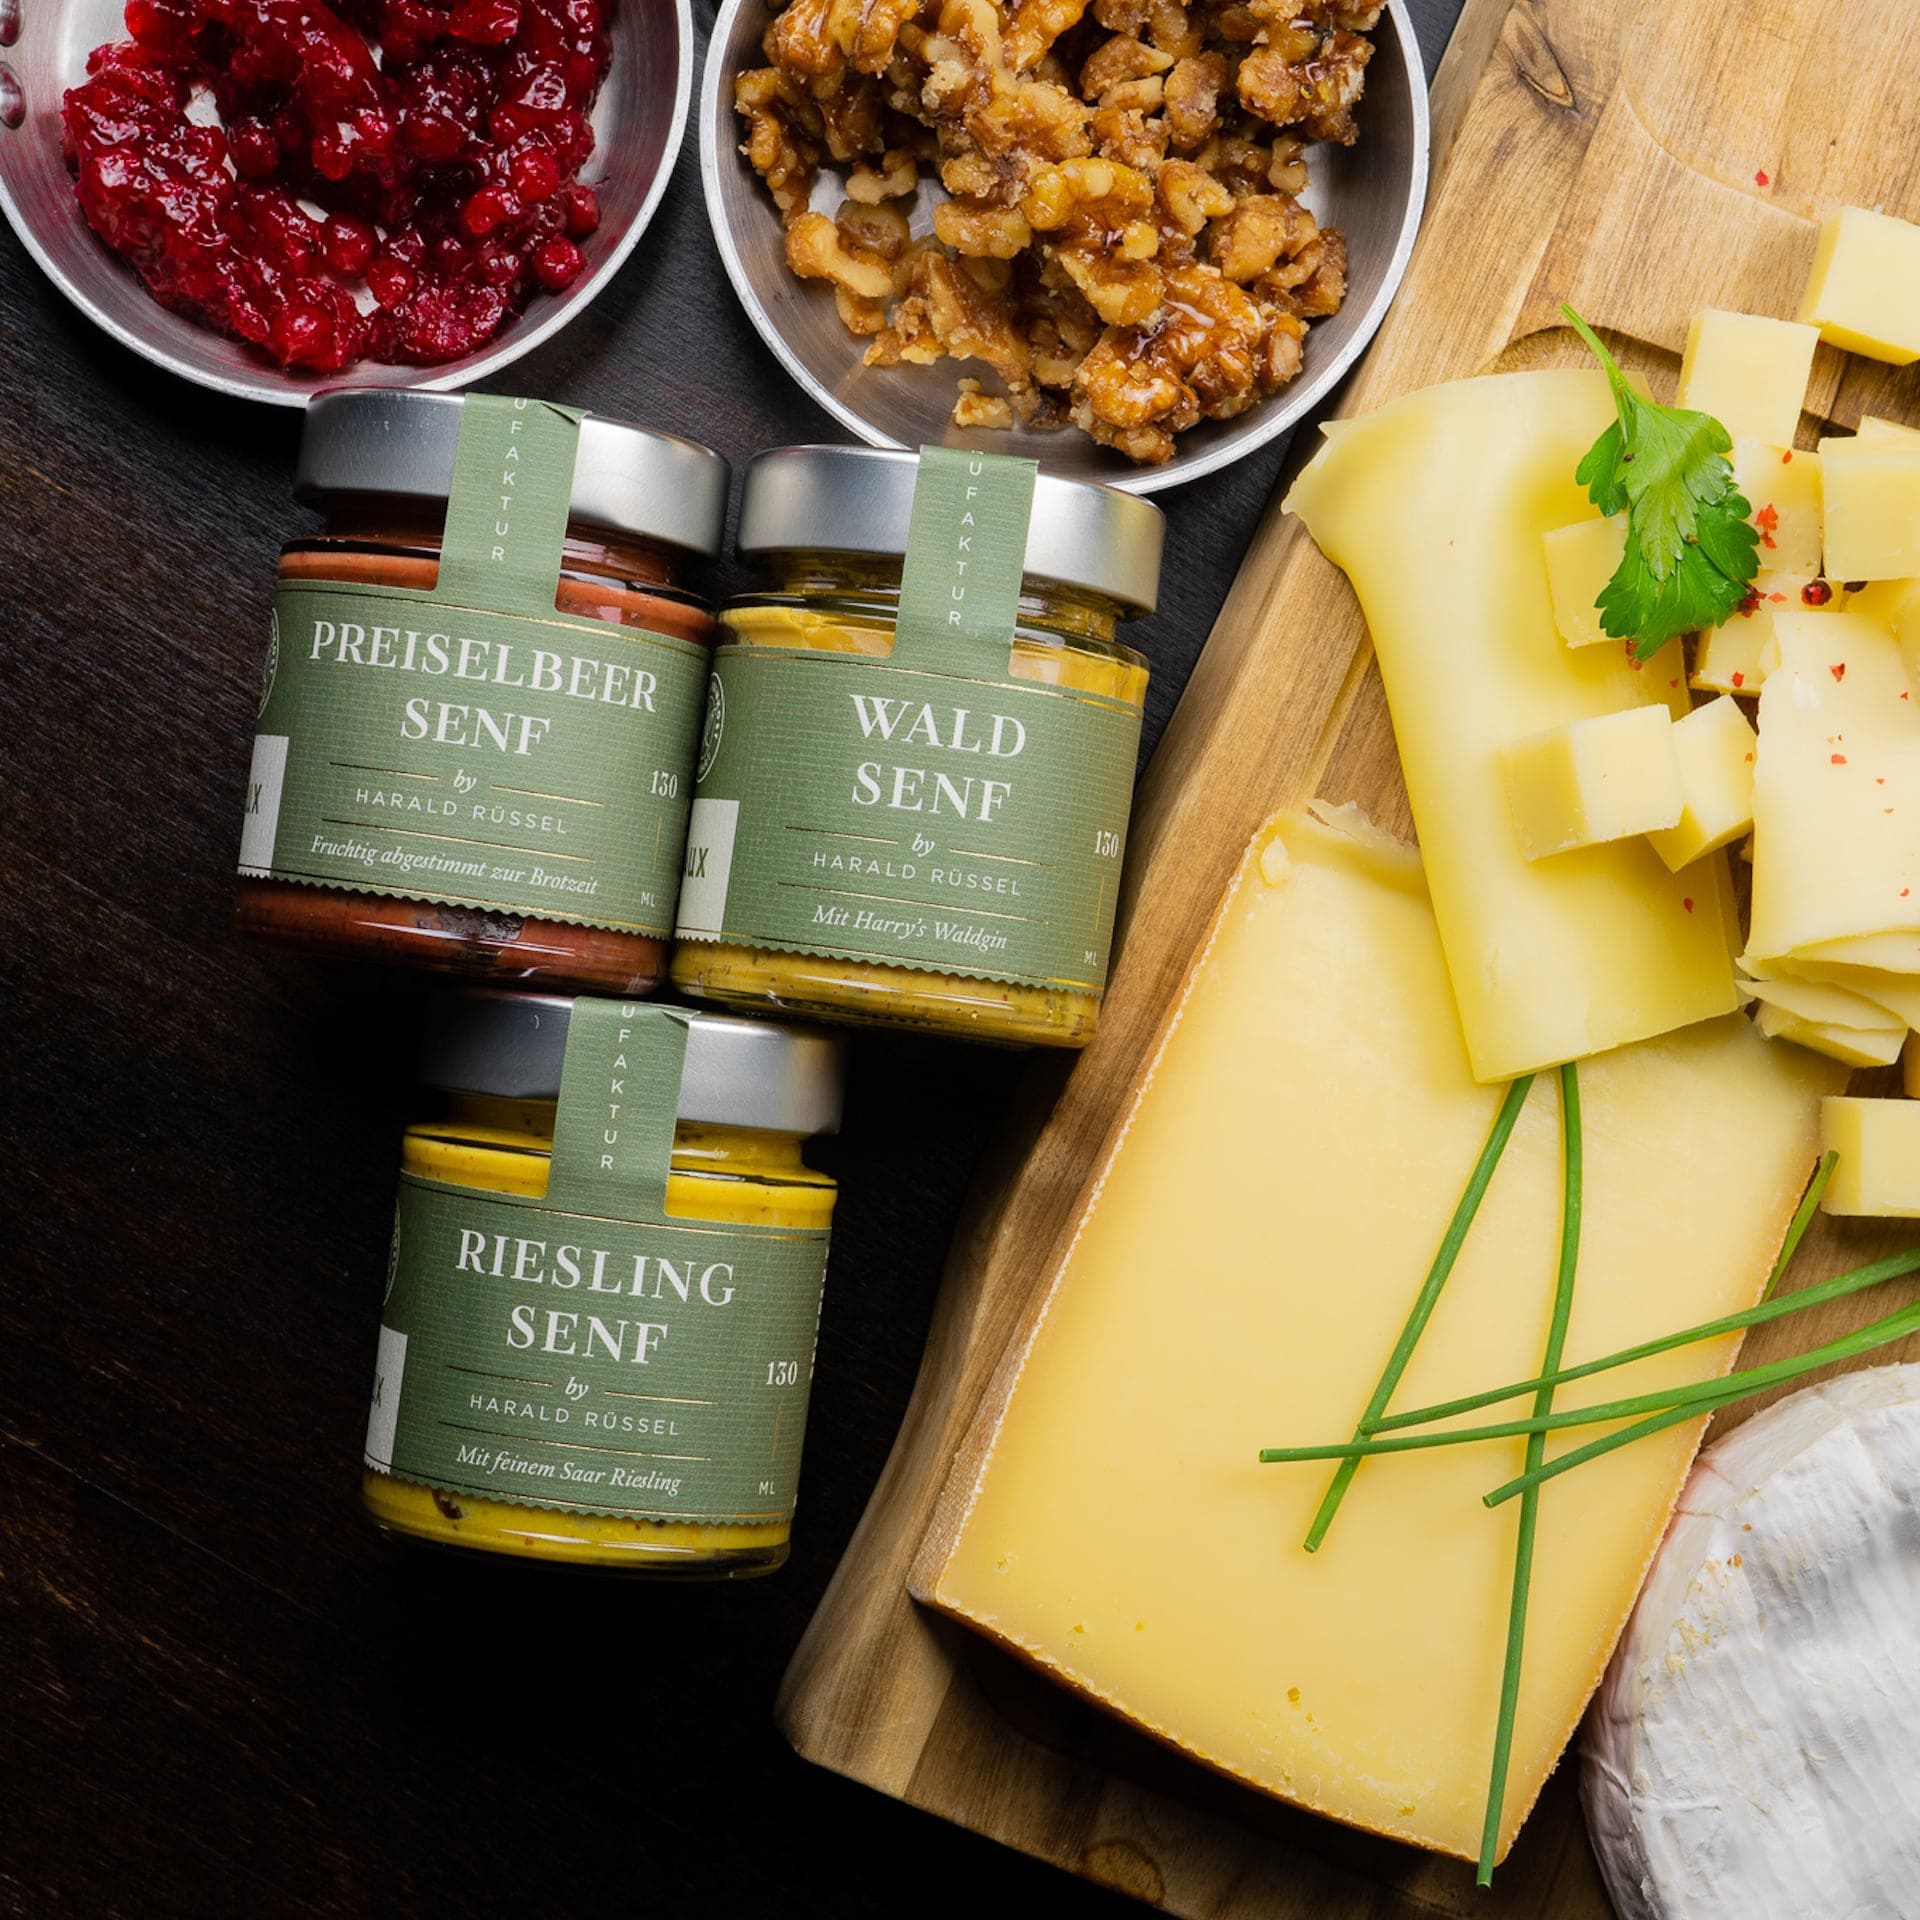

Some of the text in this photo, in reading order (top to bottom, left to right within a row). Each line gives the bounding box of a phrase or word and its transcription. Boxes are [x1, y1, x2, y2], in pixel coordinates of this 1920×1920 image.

[309, 620, 658, 713] PREISELBEER
[400, 698, 551, 756] SENF
[849, 694, 1028, 758] WALD
[453, 771, 477, 794] by
[650, 770, 678, 799] 130
[851, 762, 1013, 824] SENF
[356, 787, 568, 835] HARALD RÜSSEL
[311, 836, 599, 895] Fruchtig abgestimmt zur Brotzeit
[911, 833, 936, 857] by
[1094, 830, 1120, 858] 130
[813, 851, 1022, 897] HARALD RÜSSEL
[640, 891, 656, 908] ML
[812, 903, 849, 928] Mit
[933, 921, 1008, 951] Waldgin
[1083, 950, 1097, 966] ML
[455, 1228, 737, 1306] RIESLING
[505, 1305, 669, 1365] SENF
[565, 1377, 589, 1400] by
[766, 1361, 798, 1386] 130
[469, 1393, 679, 1437] HARALD RÜSSEL
[456, 1443, 682, 1496] Mit feinem Saar Riesling
[759, 1480, 776, 1496] ML
